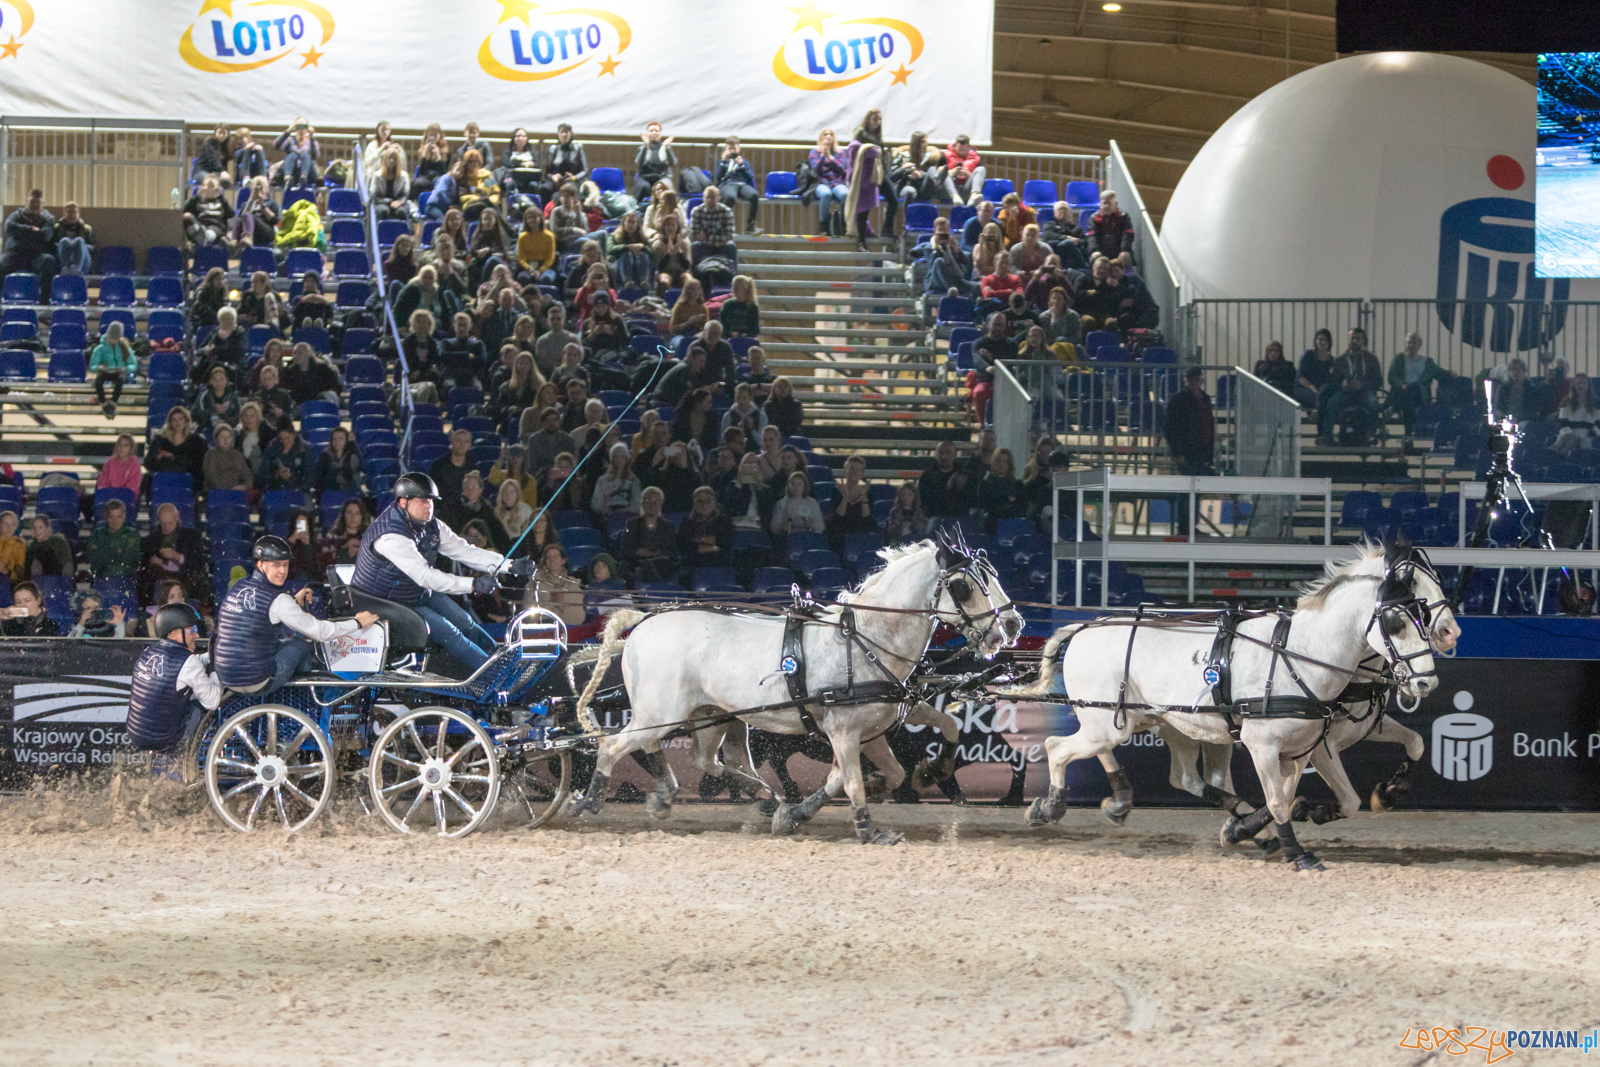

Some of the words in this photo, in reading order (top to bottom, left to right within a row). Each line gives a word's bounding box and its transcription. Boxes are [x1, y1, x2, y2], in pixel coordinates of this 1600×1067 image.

[210, 13, 304, 57] LOTTO
[509, 23, 601, 66] LOTTO
[803, 32, 894, 75] LOTTO
[350, 646, 378, 654] KOSTRZEWA
[355, 638, 367, 646] TEAM
[13, 727, 84, 748] Krajowy
[1513, 731, 1578, 757] Bank
[14, 748, 86, 766] Wsparcia
